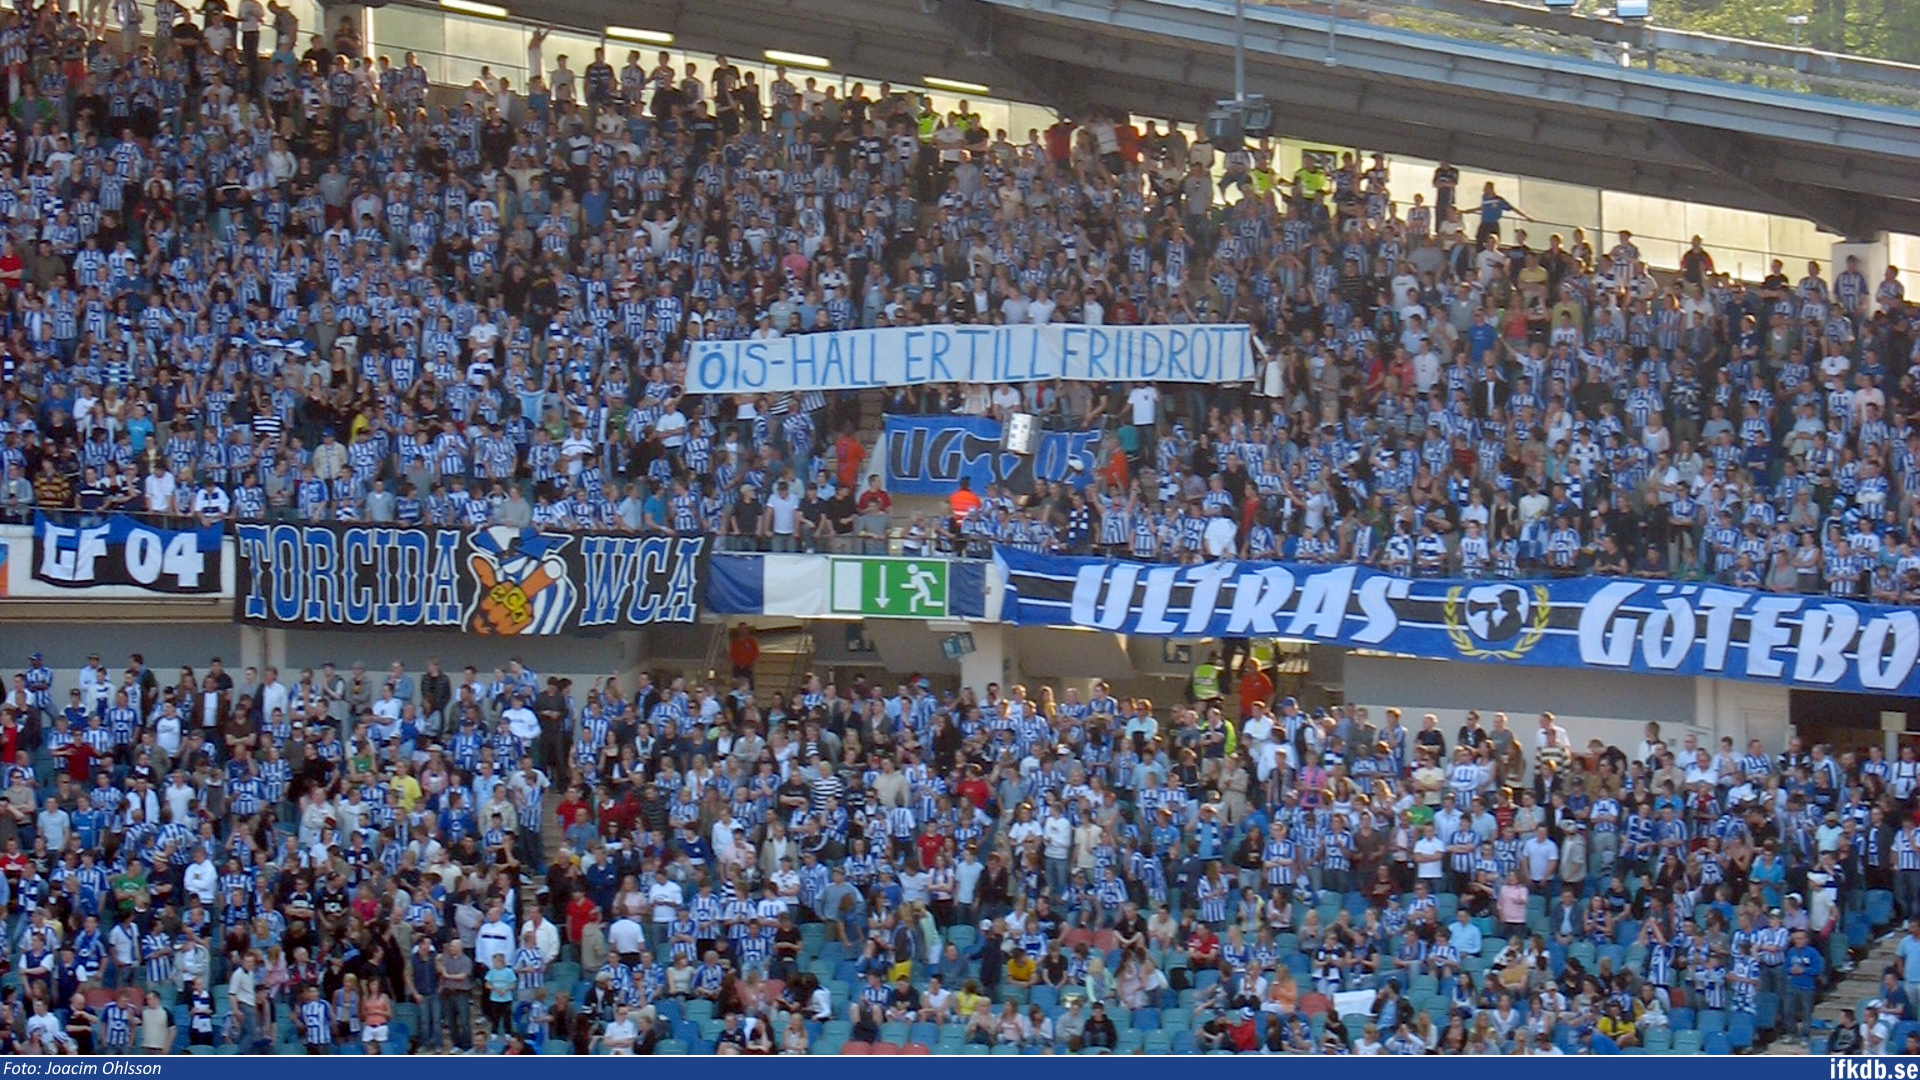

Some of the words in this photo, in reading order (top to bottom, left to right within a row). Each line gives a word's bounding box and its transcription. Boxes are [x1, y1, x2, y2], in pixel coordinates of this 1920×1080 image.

[1061, 326, 1251, 380] FRIIDROTT
[889, 427, 966, 482] UG
[40, 521, 111, 581] GF
[124, 527, 205, 587] 04
[235, 523, 463, 626] TORCIDA
[579, 536, 706, 626] WCA
[1070, 562, 1415, 644] ULTRAS
[1578, 581, 1920, 690] GÖTEBO
